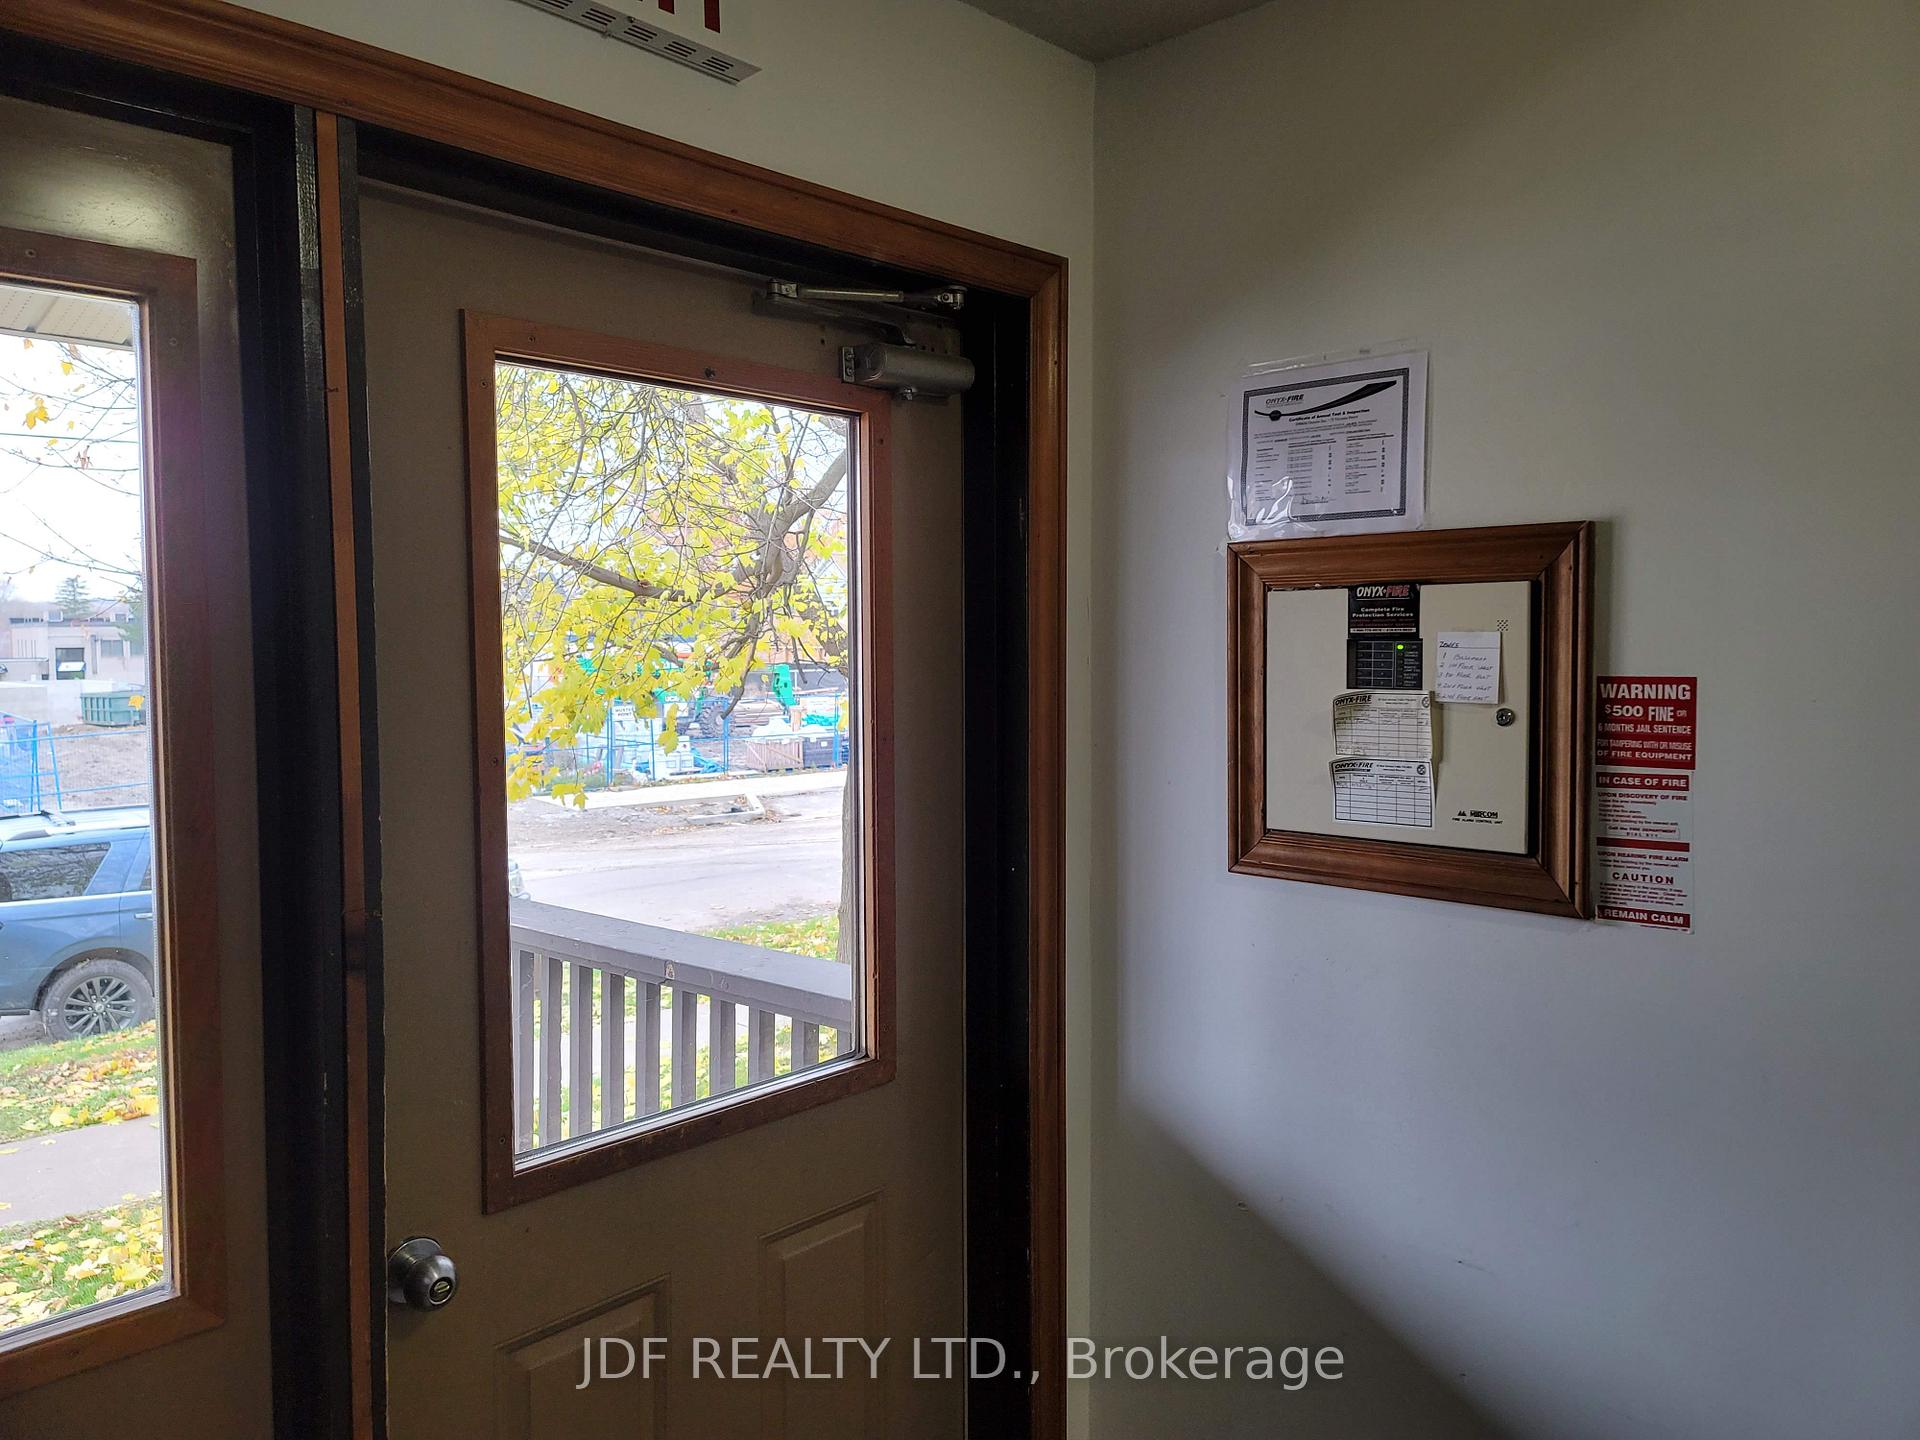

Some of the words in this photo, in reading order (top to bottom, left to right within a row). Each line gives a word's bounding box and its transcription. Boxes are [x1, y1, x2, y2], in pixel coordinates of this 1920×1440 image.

[1600, 684, 1691, 700] WARNING
[1605, 704, 1644, 717] $500
[1648, 706, 1674, 722] FINE
[1676, 709, 1687, 717] OR
[1604, 723, 1634, 732] MONTHS
[1636, 724, 1652, 733] JAIL
[1653, 725, 1692, 734] SENTENCE
[1610, 739, 1642, 749] TAMPERING
[1643, 741, 1658, 749] WITH
[1635, 751, 1693, 760] EQUIPMENT
[1599, 776, 1610, 784] IN
[1613, 777, 1641, 785] CASE
[1644, 778, 1659, 786] OF
[1662, 779, 1687, 787] FIRE
[1612, 872, 1674, 884] CAUTION
[1604, 909, 1648, 921] REMAIN
[1651, 914, 1684, 924] CALM
